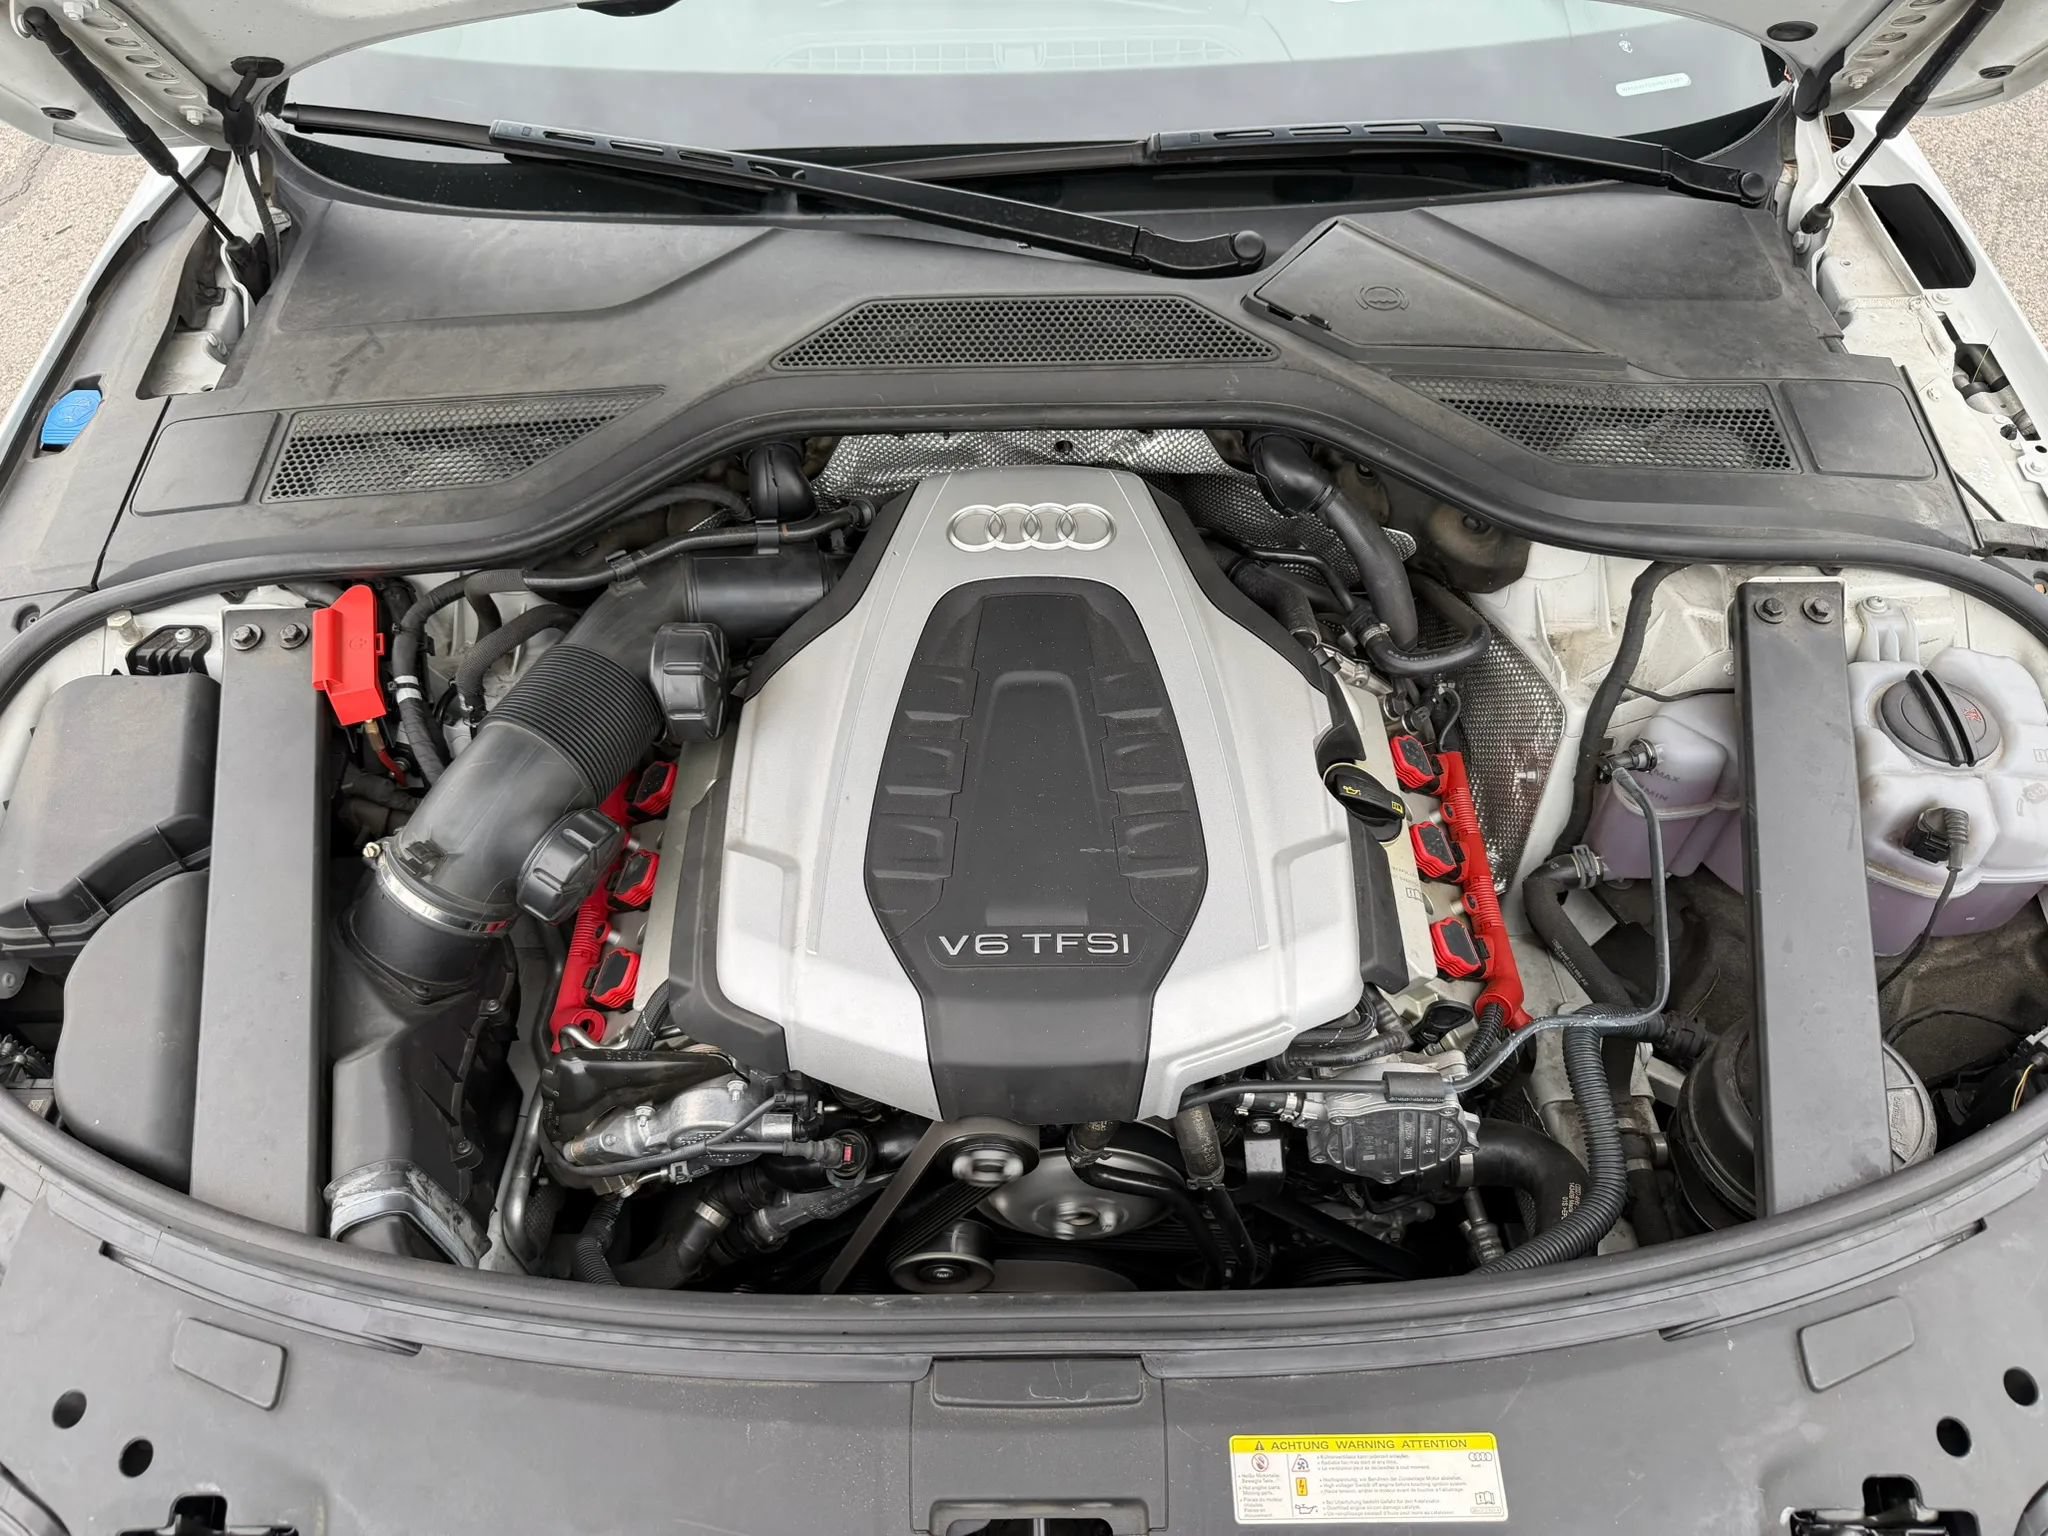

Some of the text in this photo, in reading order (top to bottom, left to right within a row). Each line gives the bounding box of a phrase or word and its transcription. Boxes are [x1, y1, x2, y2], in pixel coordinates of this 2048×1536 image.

[1654, 769, 1681, 782] MAX
[938, 932, 1130, 956] V6 TFSI
[1271, 1438, 1468, 1450] ACHTUNG WARNING ATTENTION
